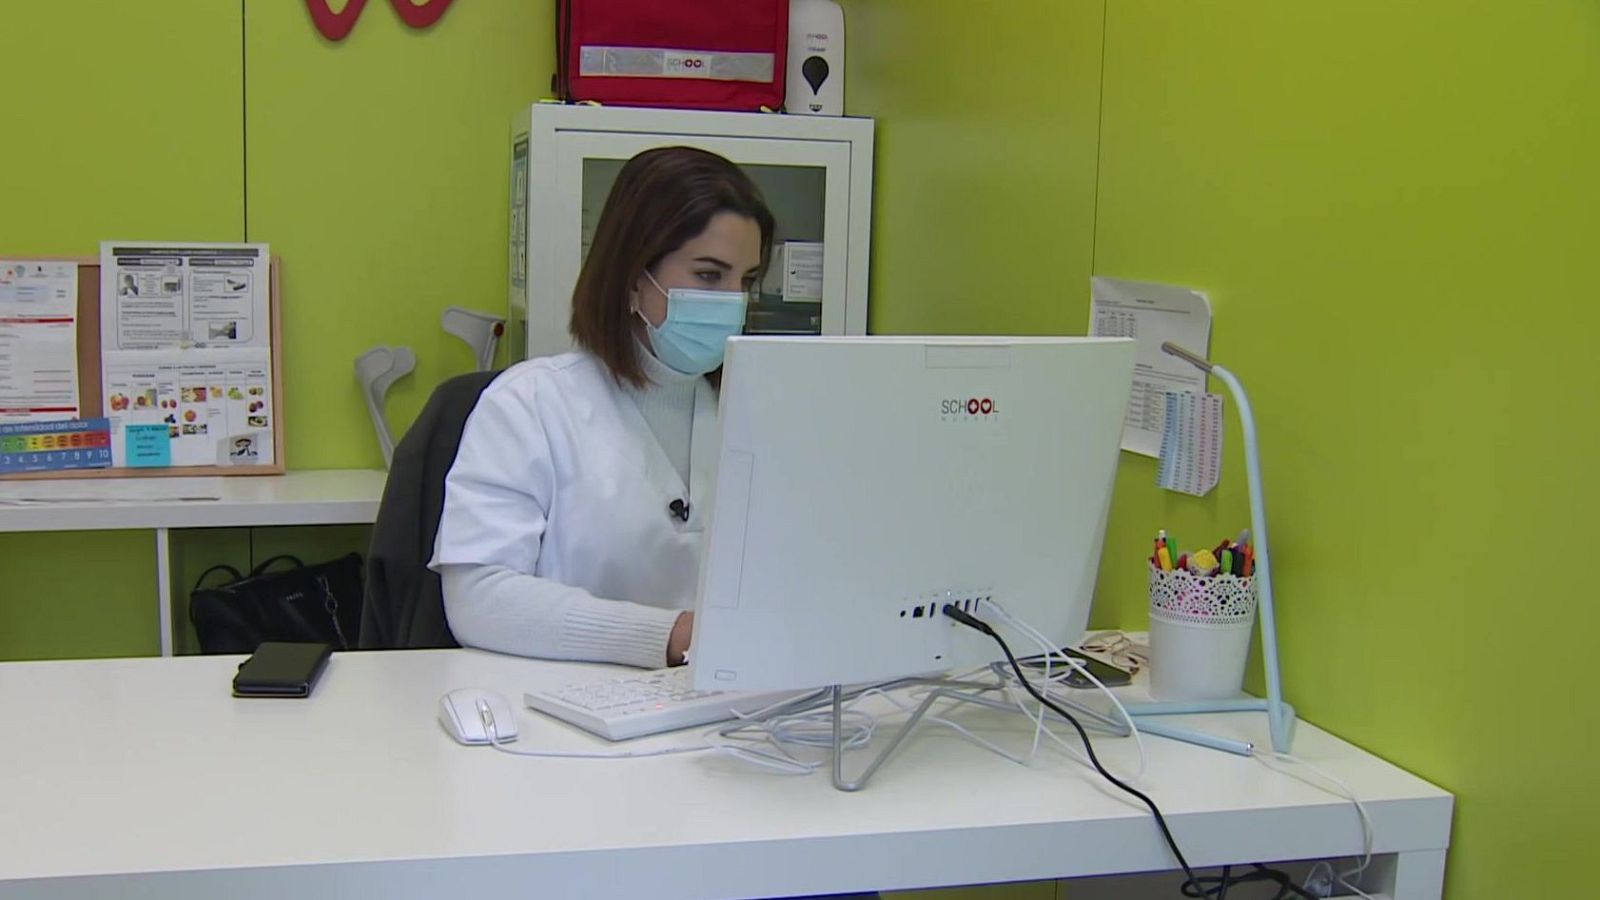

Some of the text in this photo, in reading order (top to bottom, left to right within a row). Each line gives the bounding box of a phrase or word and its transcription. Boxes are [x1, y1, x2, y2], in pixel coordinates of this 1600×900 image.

[667, 57, 705, 68] SCHOOL
[941, 398, 999, 415] SCHOOL
[99, 449, 109, 458] 10
